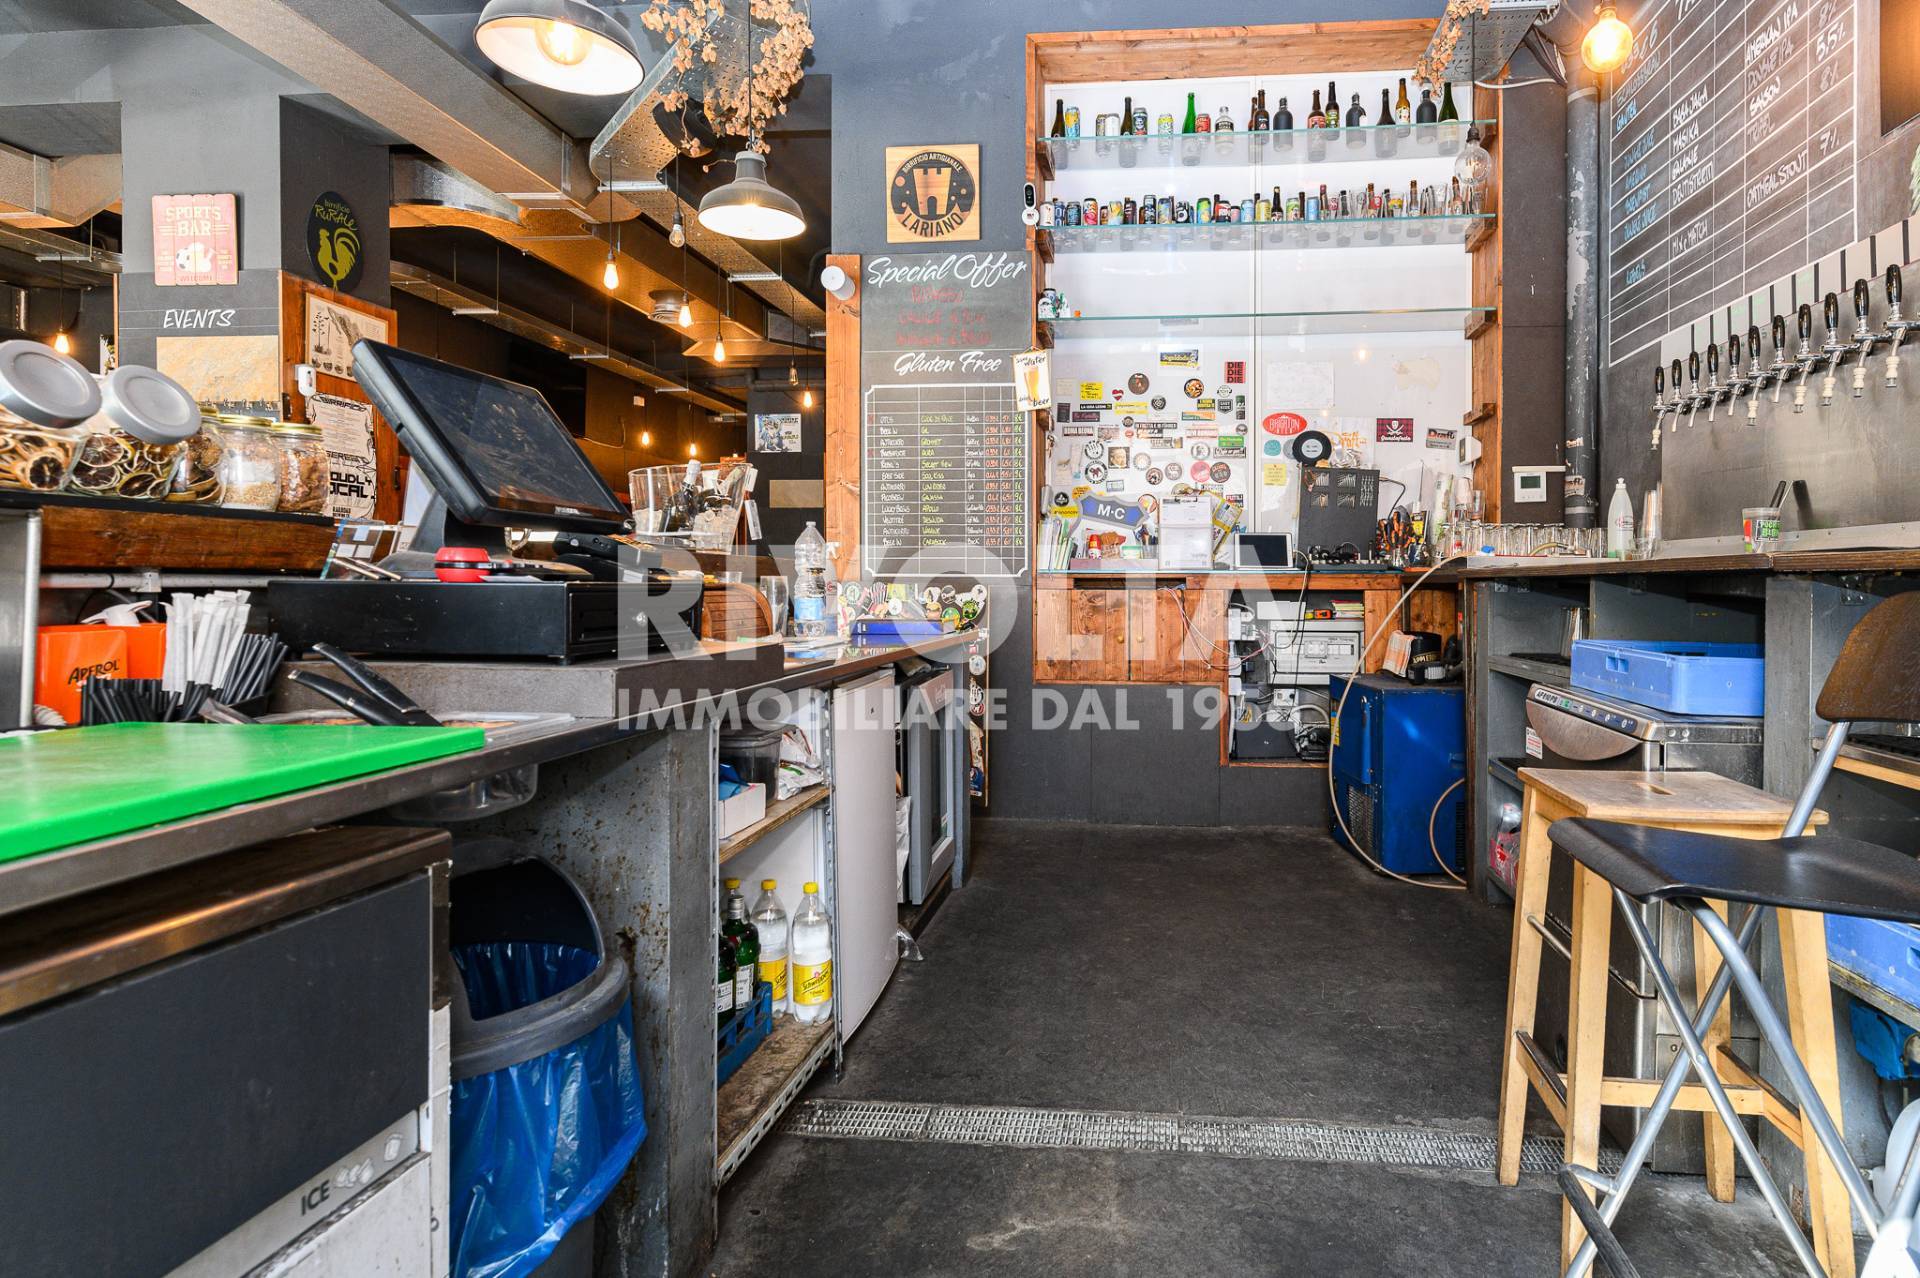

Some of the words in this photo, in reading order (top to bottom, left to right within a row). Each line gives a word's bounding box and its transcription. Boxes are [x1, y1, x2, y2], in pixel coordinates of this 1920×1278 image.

[1783, 1, 1798, 31] IPA
[1750, 75, 1780, 116] SAISON
[1820, 127, 1840, 156] 7%
[902, 153, 928, 173] BIRRIFICIO
[929, 153, 963, 172] ARTIGIANALE
[1778, 149, 1808, 185] STOUT
[166, 206, 222, 221] SPORTS
[901, 212, 963, 237] LARIANO
[176, 220, 211, 236] BAR
[868, 254, 958, 288] Special
[953, 252, 1028, 288] Offer
[163, 309, 236, 328] EVENTS
[894, 352, 955, 376] Gluten
[959, 351, 1001, 373] Free
[331, 471, 372, 485] OUDLY
[68, 658, 120, 684] APEROL
[301, 1179, 330, 1216] ICE
